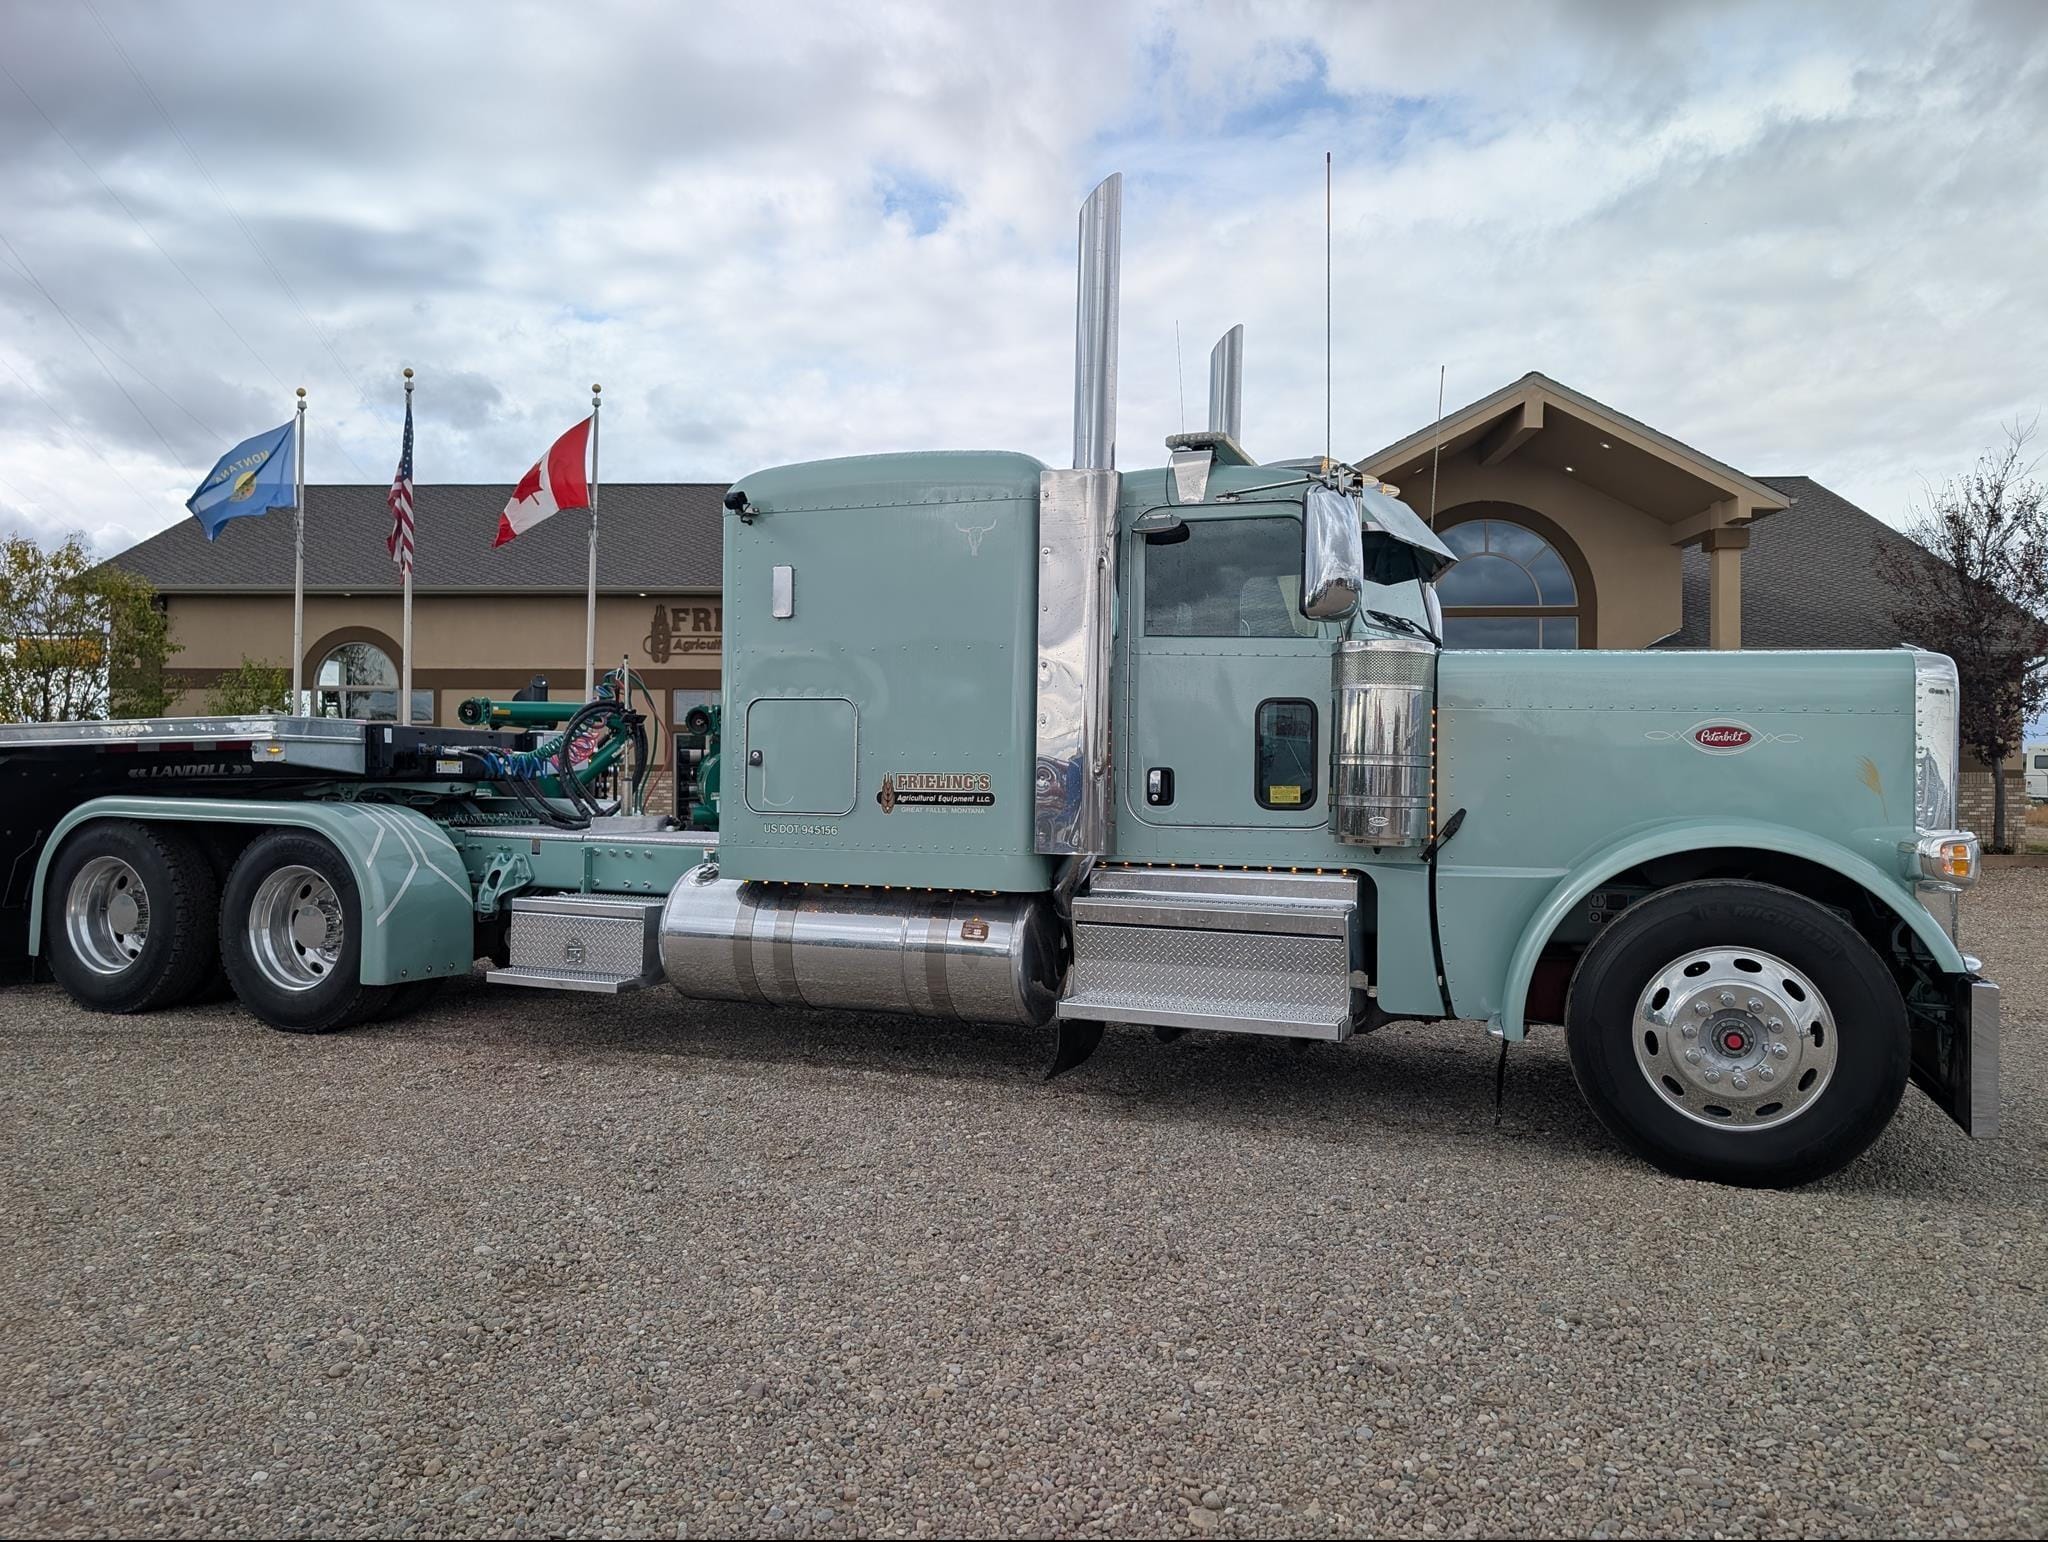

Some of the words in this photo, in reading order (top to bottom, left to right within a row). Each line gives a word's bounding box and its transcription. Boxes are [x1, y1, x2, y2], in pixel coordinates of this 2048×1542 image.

[1701, 729, 1747, 742] Peterbilt
[151, 764, 229, 778] LANDOLL
[897, 774, 990, 790] FRIELING'S
[897, 794, 936, 804] Agricultural
[938, 794, 975, 804] Equipment
[764, 823, 778, 834] US
[780, 824, 799, 834] DOT
[801, 824, 838, 836] 945156
